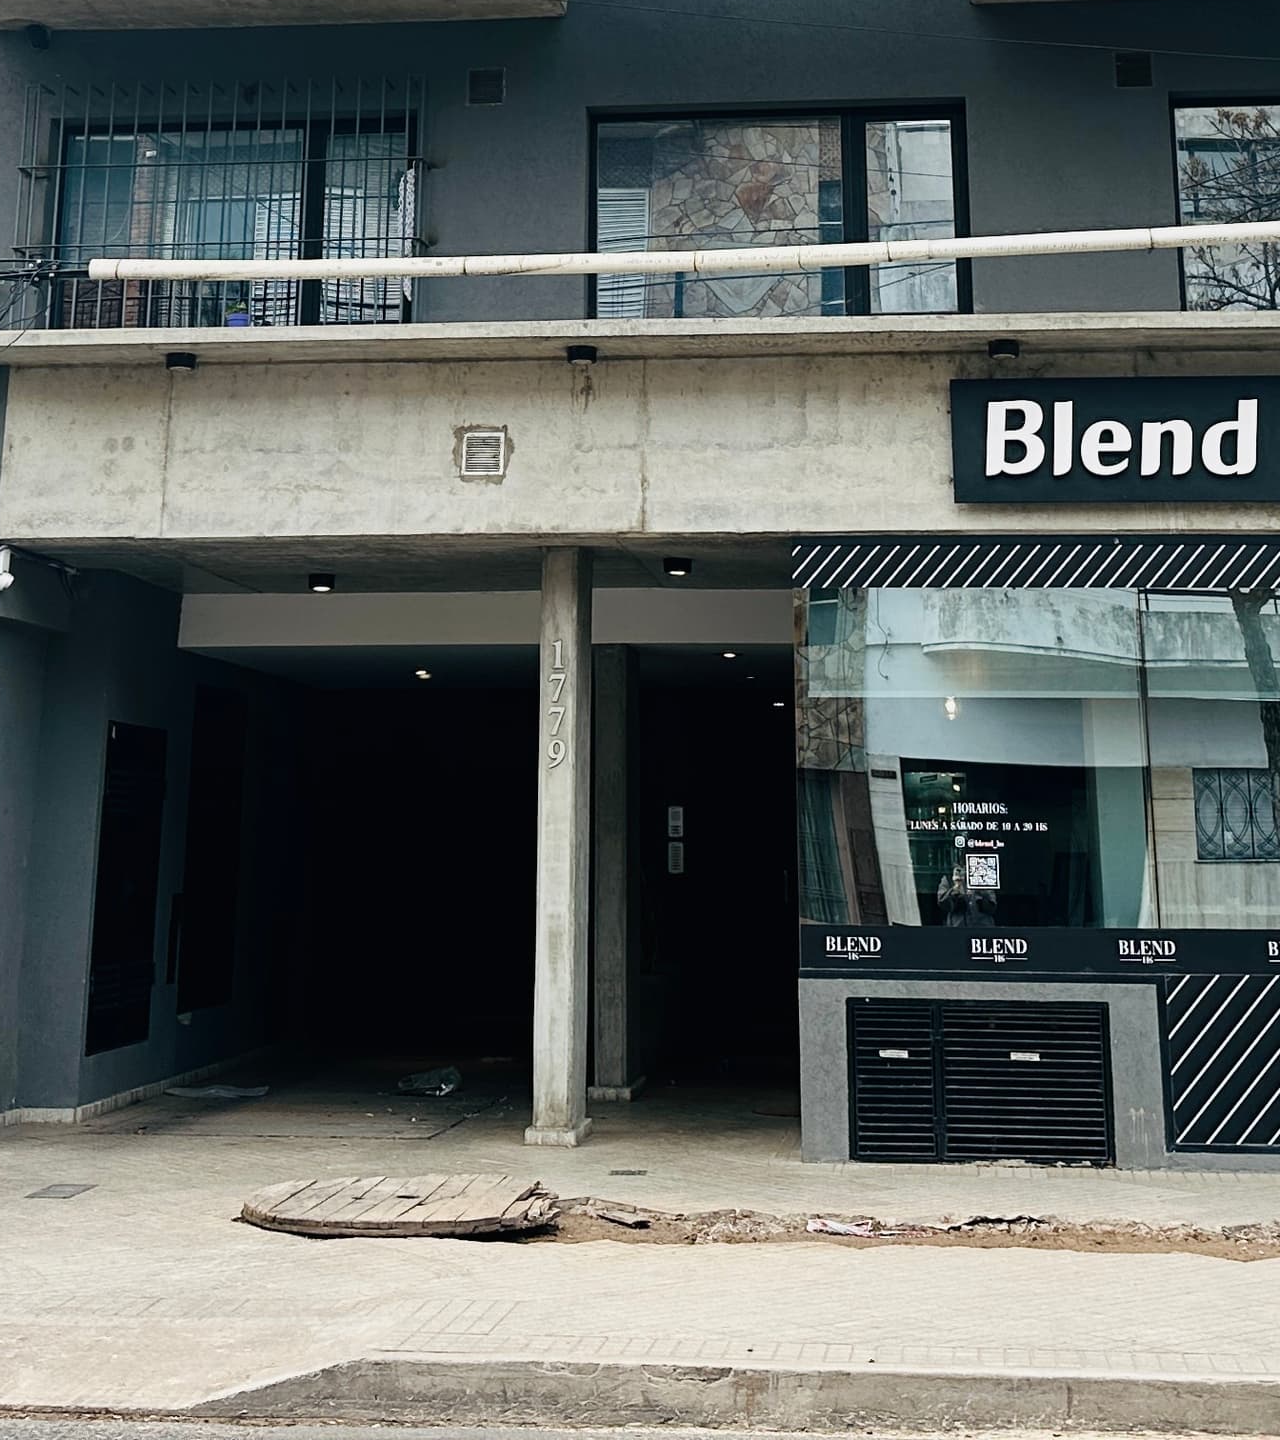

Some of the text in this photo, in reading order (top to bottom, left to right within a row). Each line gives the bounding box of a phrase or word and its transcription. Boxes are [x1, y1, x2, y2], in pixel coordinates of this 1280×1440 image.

[985, 398, 1258, 477] Blend
[547, 639, 567, 769] 1779
[953, 802, 1008, 814] HORARIOS:
[986, 821, 999, 831] DE
[1013, 822, 1020, 831] A
[826, 935, 882, 952] BLEND
[971, 938, 1028, 954] BLEND
[1118, 939, 1176, 956] BLEND
